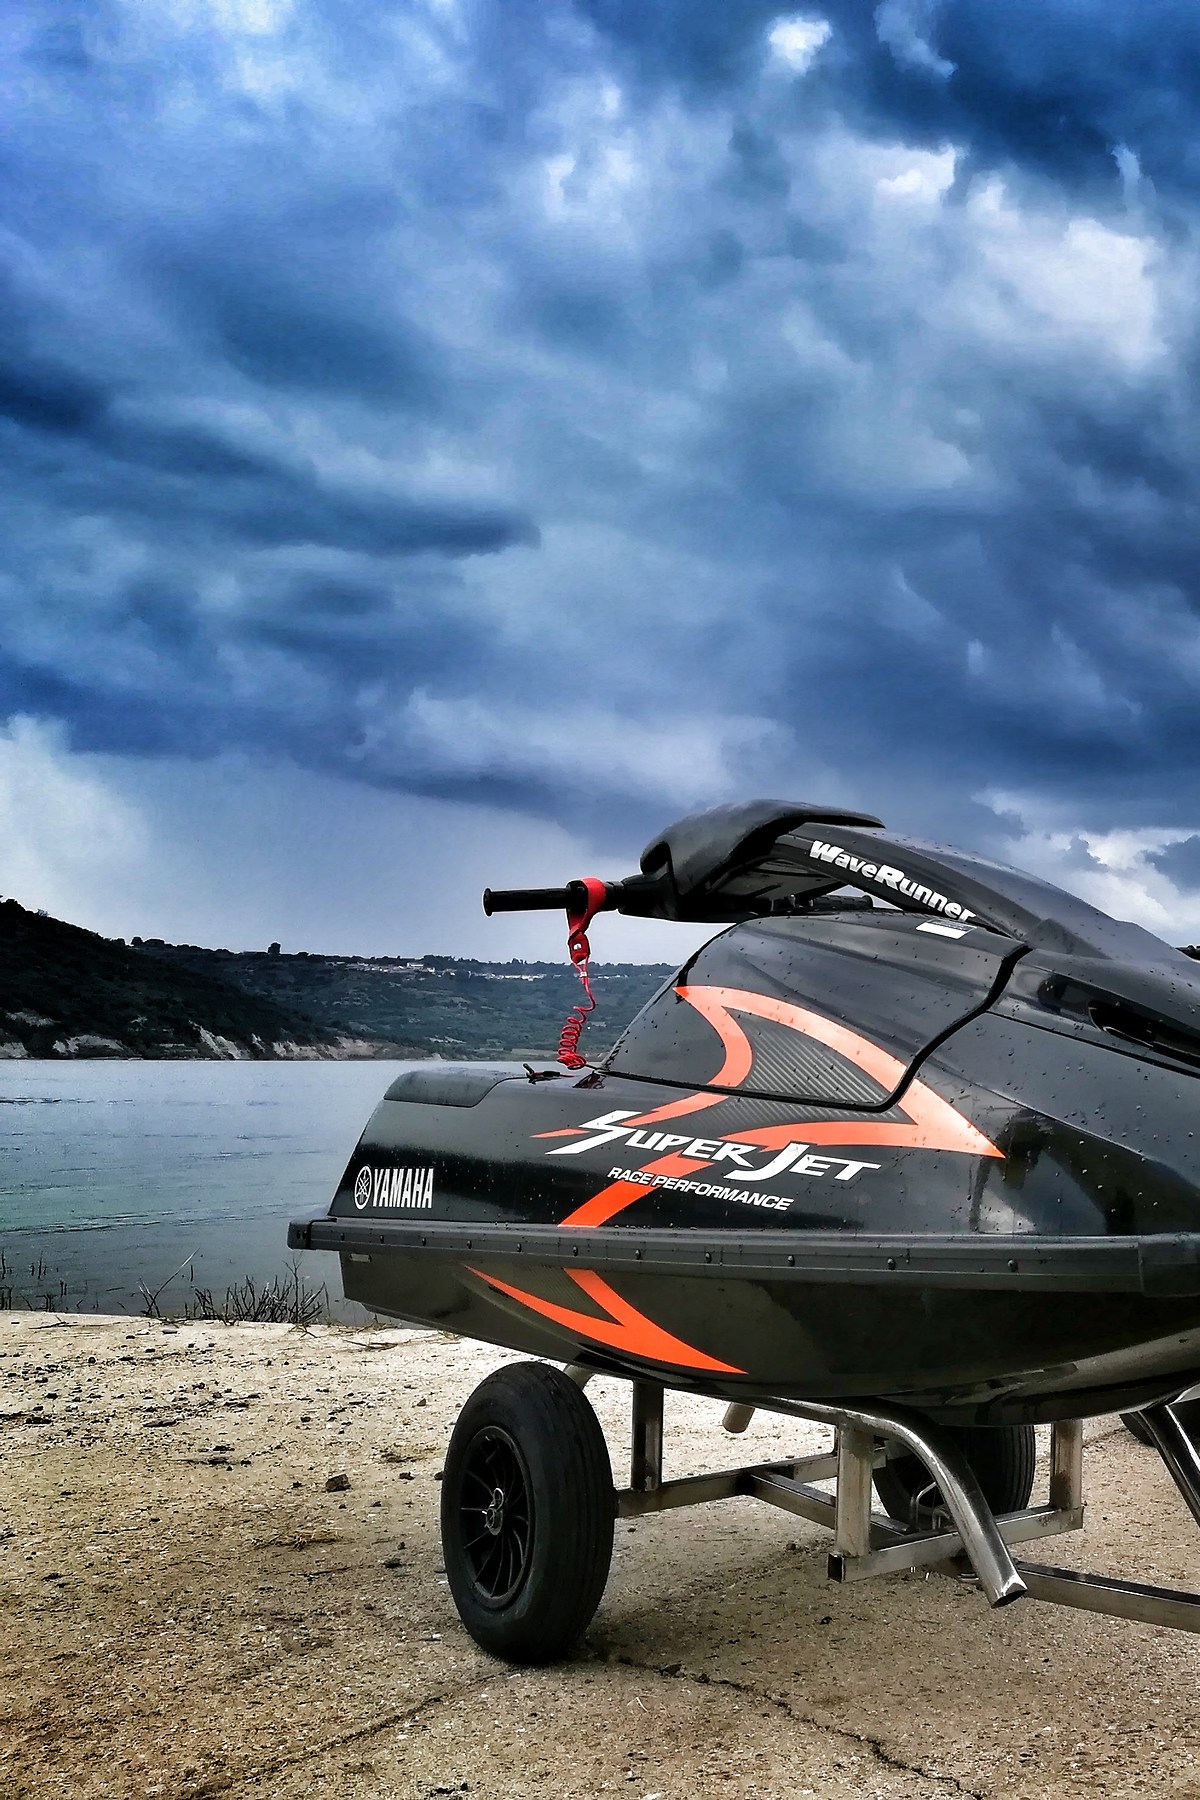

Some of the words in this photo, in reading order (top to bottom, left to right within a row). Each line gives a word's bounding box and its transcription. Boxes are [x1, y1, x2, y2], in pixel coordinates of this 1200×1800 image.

[810, 840, 976, 922] WaveRunner
[373, 1169, 434, 1208] YAMAHA
[608, 1167, 652, 1186] RACE
[651, 1176, 794, 1211] PERFORMANCE
